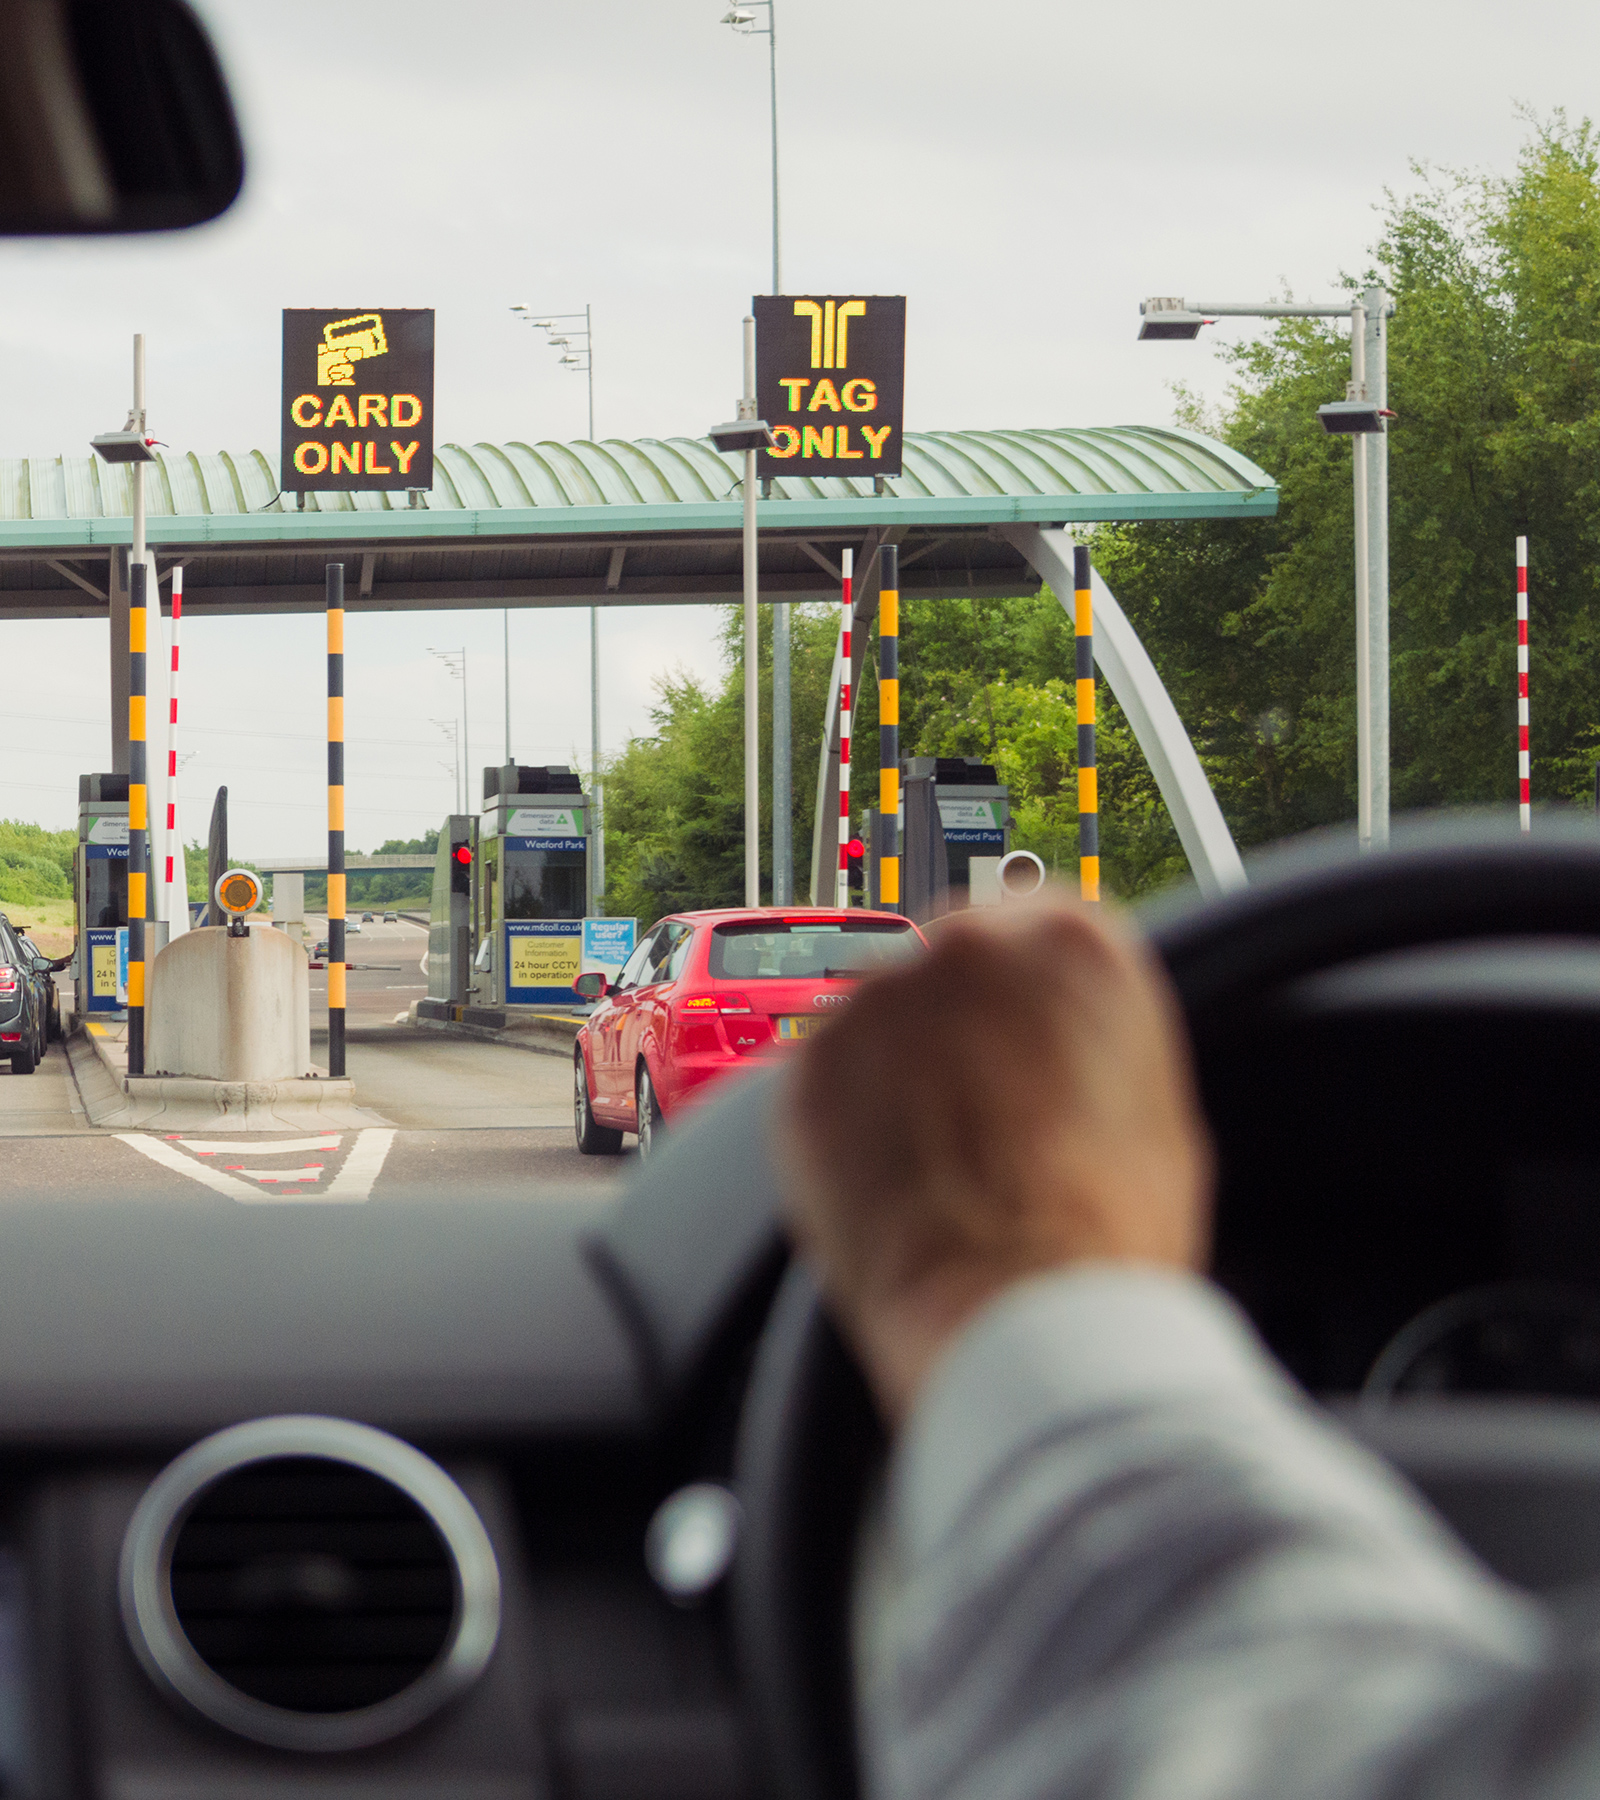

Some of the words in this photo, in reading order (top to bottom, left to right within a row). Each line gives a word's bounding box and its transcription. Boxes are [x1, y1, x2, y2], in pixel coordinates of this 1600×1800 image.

[778, 377, 878, 413] TAG
[290, 393, 423, 428] CARD
[765, 424, 892, 459] ONLY
[293, 440, 421, 475] ONLY
[943, 832, 981, 841] Weeford
[982, 832, 1003, 841] Park
[524, 840, 564, 849] Weeford
[565, 840, 585, 849] Park
[106, 848, 129, 857] Weef
[590, 923, 630, 932] Regular
[595, 930, 623, 938] user?
[514, 961, 525, 969] 24
[528, 961, 549, 969] hour
[552, 961, 578, 969] CCTV
[96, 970, 107, 978] 24
[530, 971, 574, 980] operation
